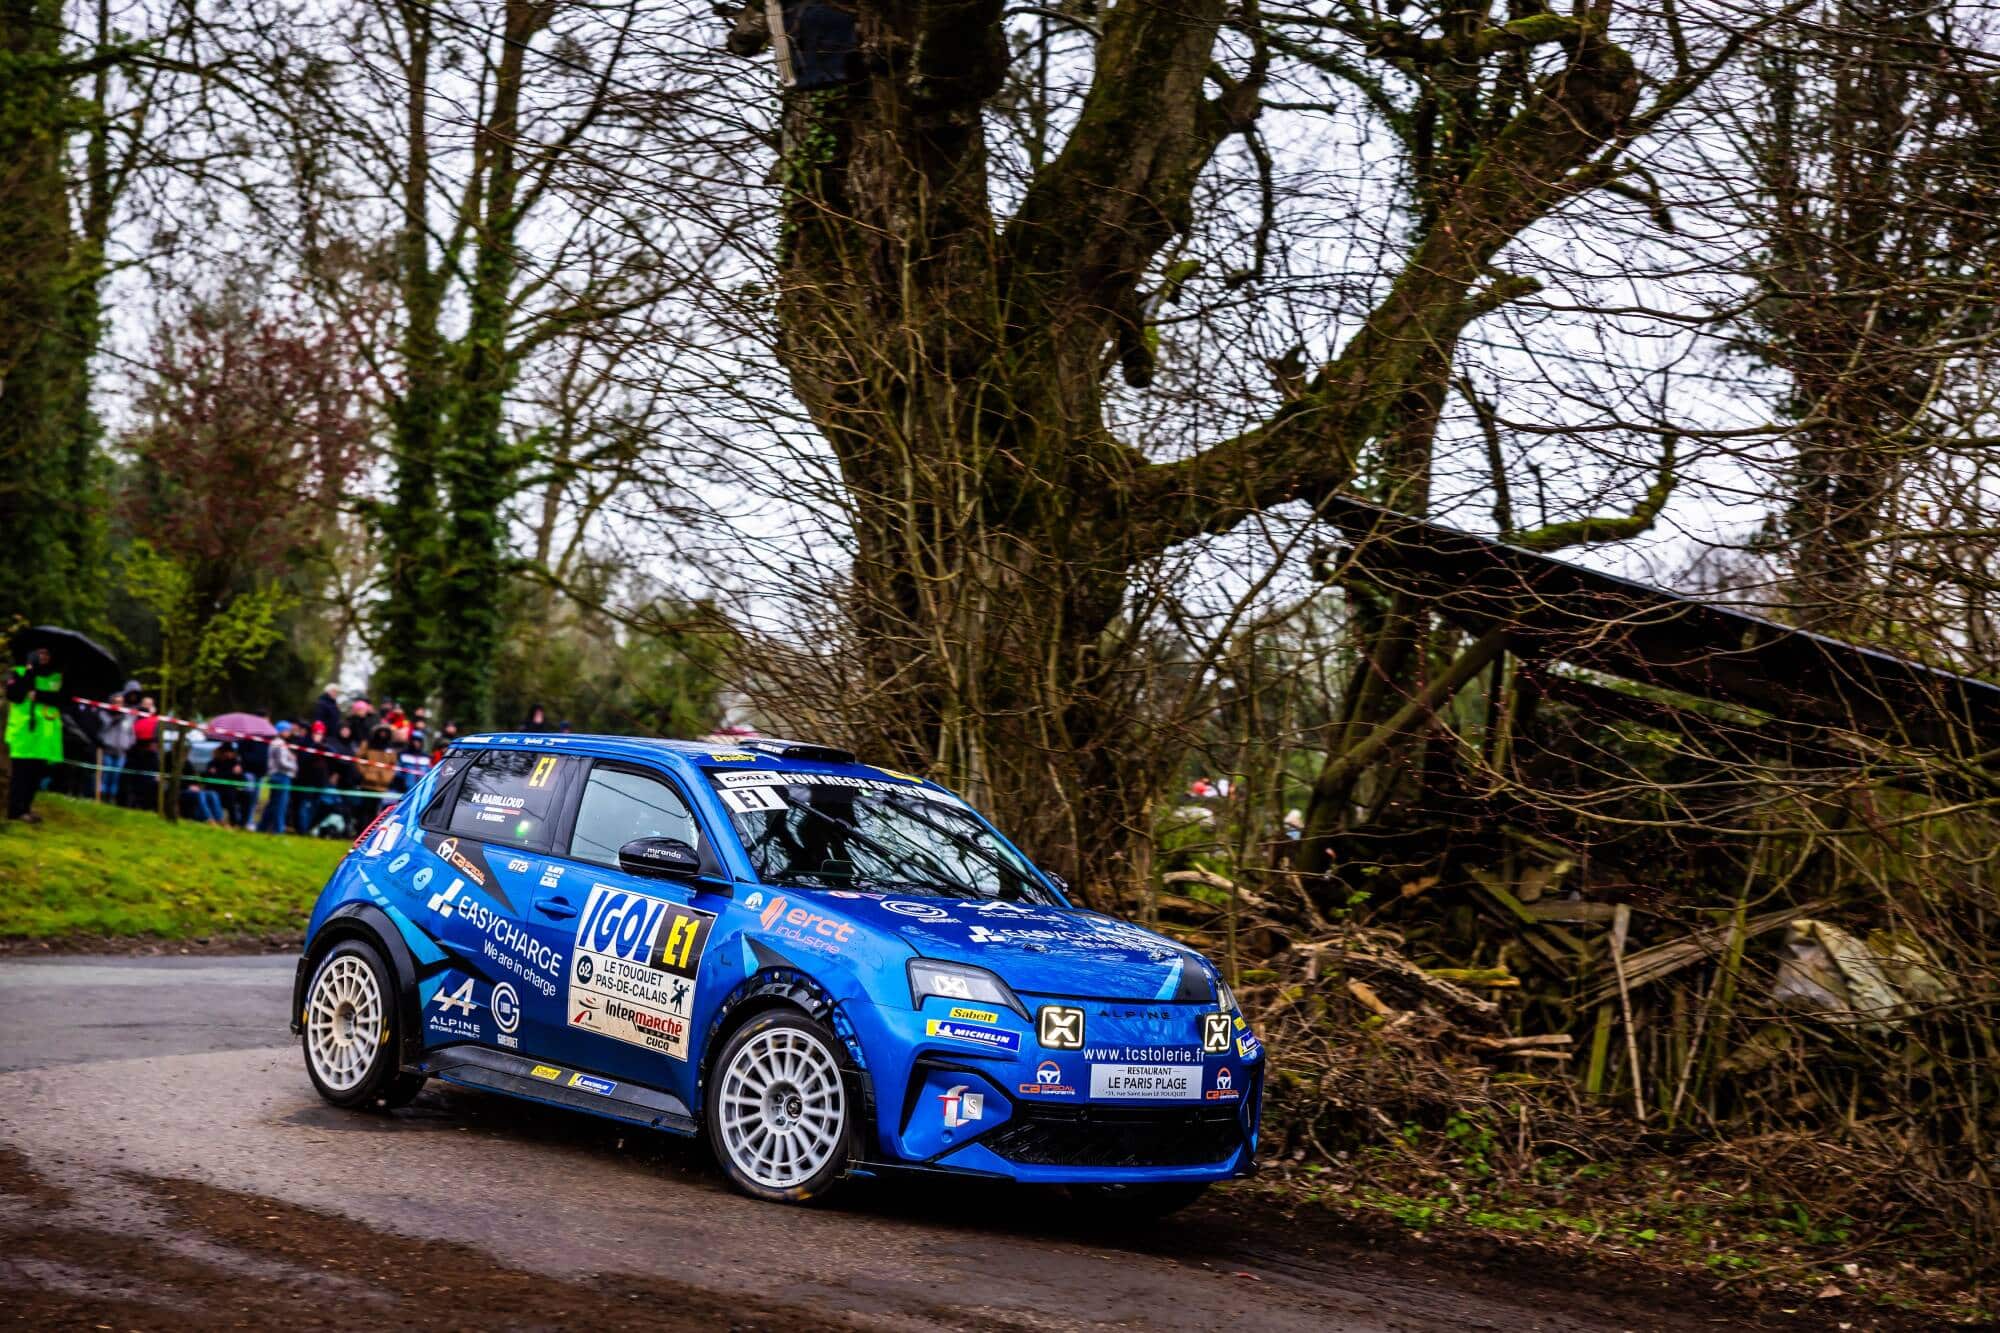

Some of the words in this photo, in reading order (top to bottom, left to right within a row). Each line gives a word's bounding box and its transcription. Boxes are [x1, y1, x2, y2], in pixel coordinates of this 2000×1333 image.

[528, 756, 557, 787] E1
[782, 774, 820, 785] FUN
[732, 789, 769, 808] E1
[647, 847, 682, 859] miranda
[578, 890, 665, 964] IGOL
[662, 914, 701, 969] E1
[786, 908, 856, 942] erct
[459, 896, 563, 977] EASYCHARGE
[775, 923, 841, 954] industrie
[484, 939, 498, 960] We
[497, 952, 513, 971] are
[514, 960, 522, 975] in
[523, 967, 556, 996] charge
[577, 958, 592, 978] 62
[604, 960, 616, 974] LE
[618, 964, 663, 986] TOUQUET
[595, 974, 668, 1005] PAS-DE-CALAIS
[430, 1015, 481, 1033] ALPINE
[953, 1008, 994, 1022] Sabelt
[1098, 1010, 1173, 1020] ALPINE
[646, 1036, 670, 1051] CUCQ
[954, 1028, 1011, 1044] MICHELIN
[1083, 1046, 1205, 1063] www.tcstolerie.fr
[1127, 1066, 1173, 1076] RESTAURANT
[1108, 1077, 1121, 1089] LE
[1124, 1077, 1153, 1090] PARIS
[1155, 1078, 1187, 1090] PLAGE
